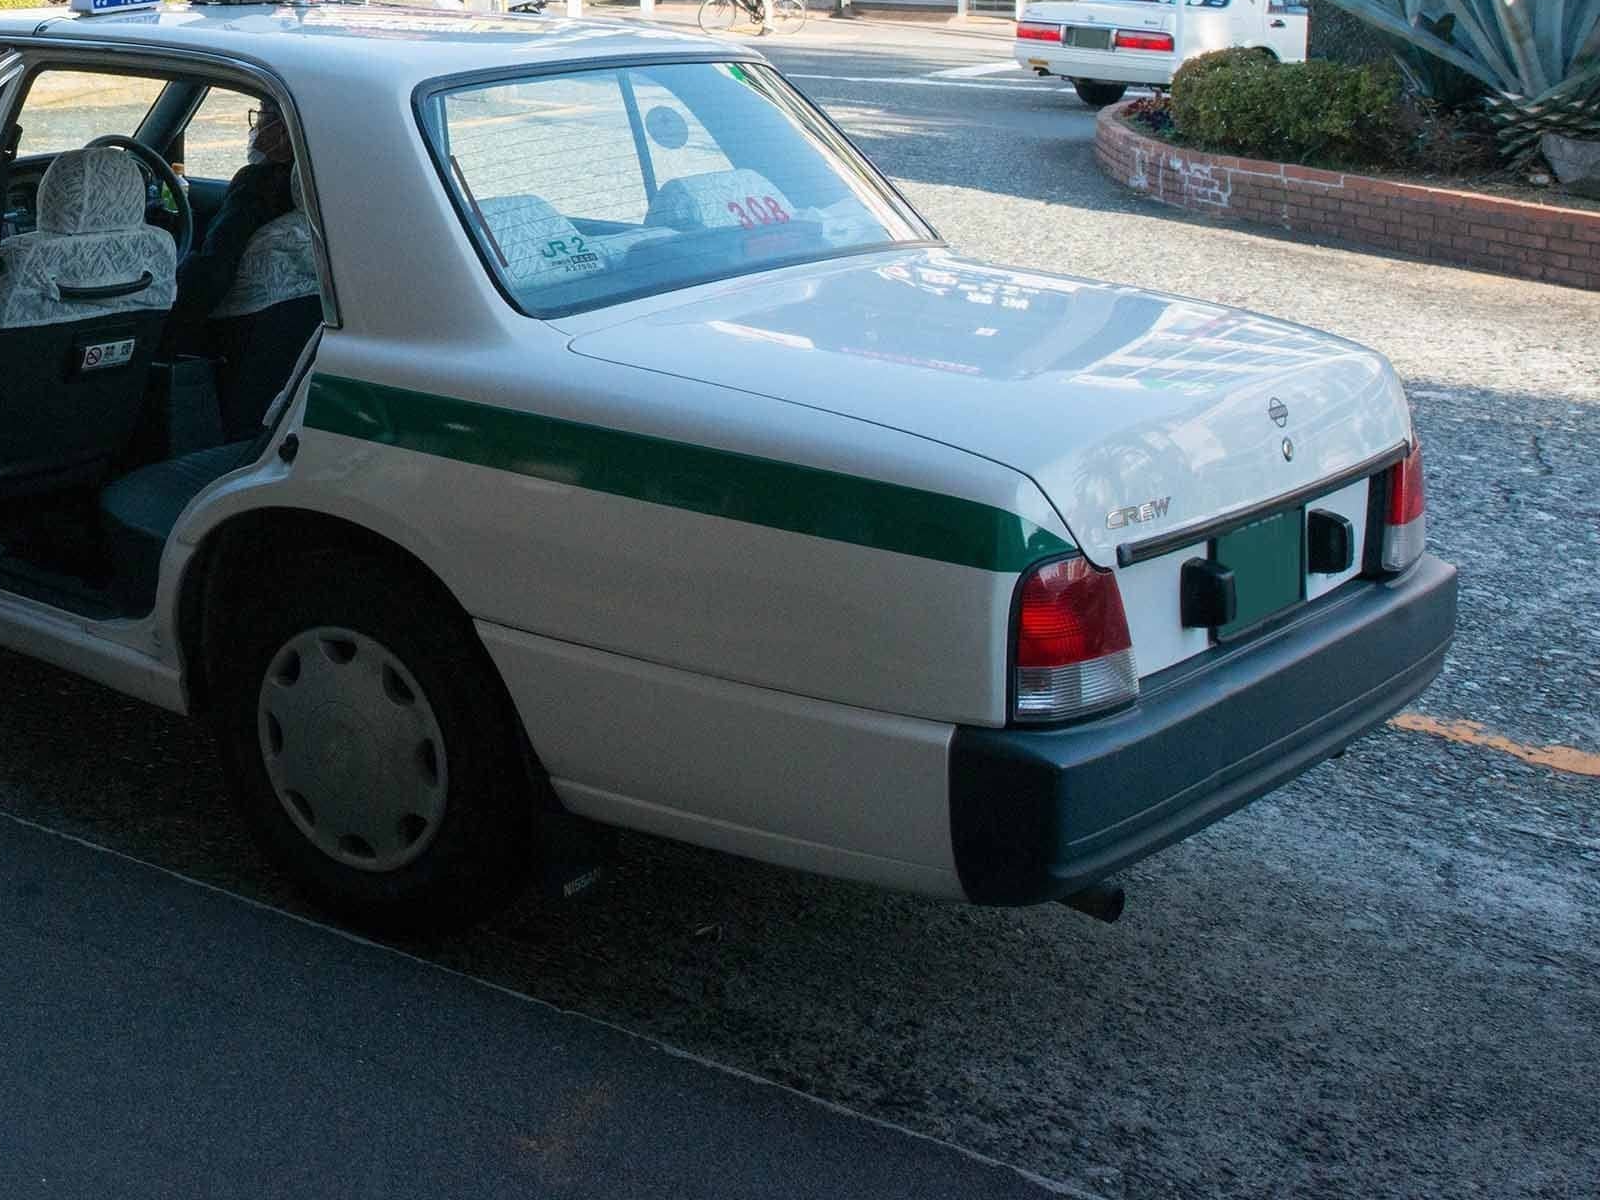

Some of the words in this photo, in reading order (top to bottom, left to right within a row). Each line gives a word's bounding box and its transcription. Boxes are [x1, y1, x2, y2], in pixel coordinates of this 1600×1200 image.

[727, 194, 790, 231] 308
[542, 240, 570, 258] JR
[571, 236, 590, 253] 2
[1106, 496, 1172, 530] CREW
